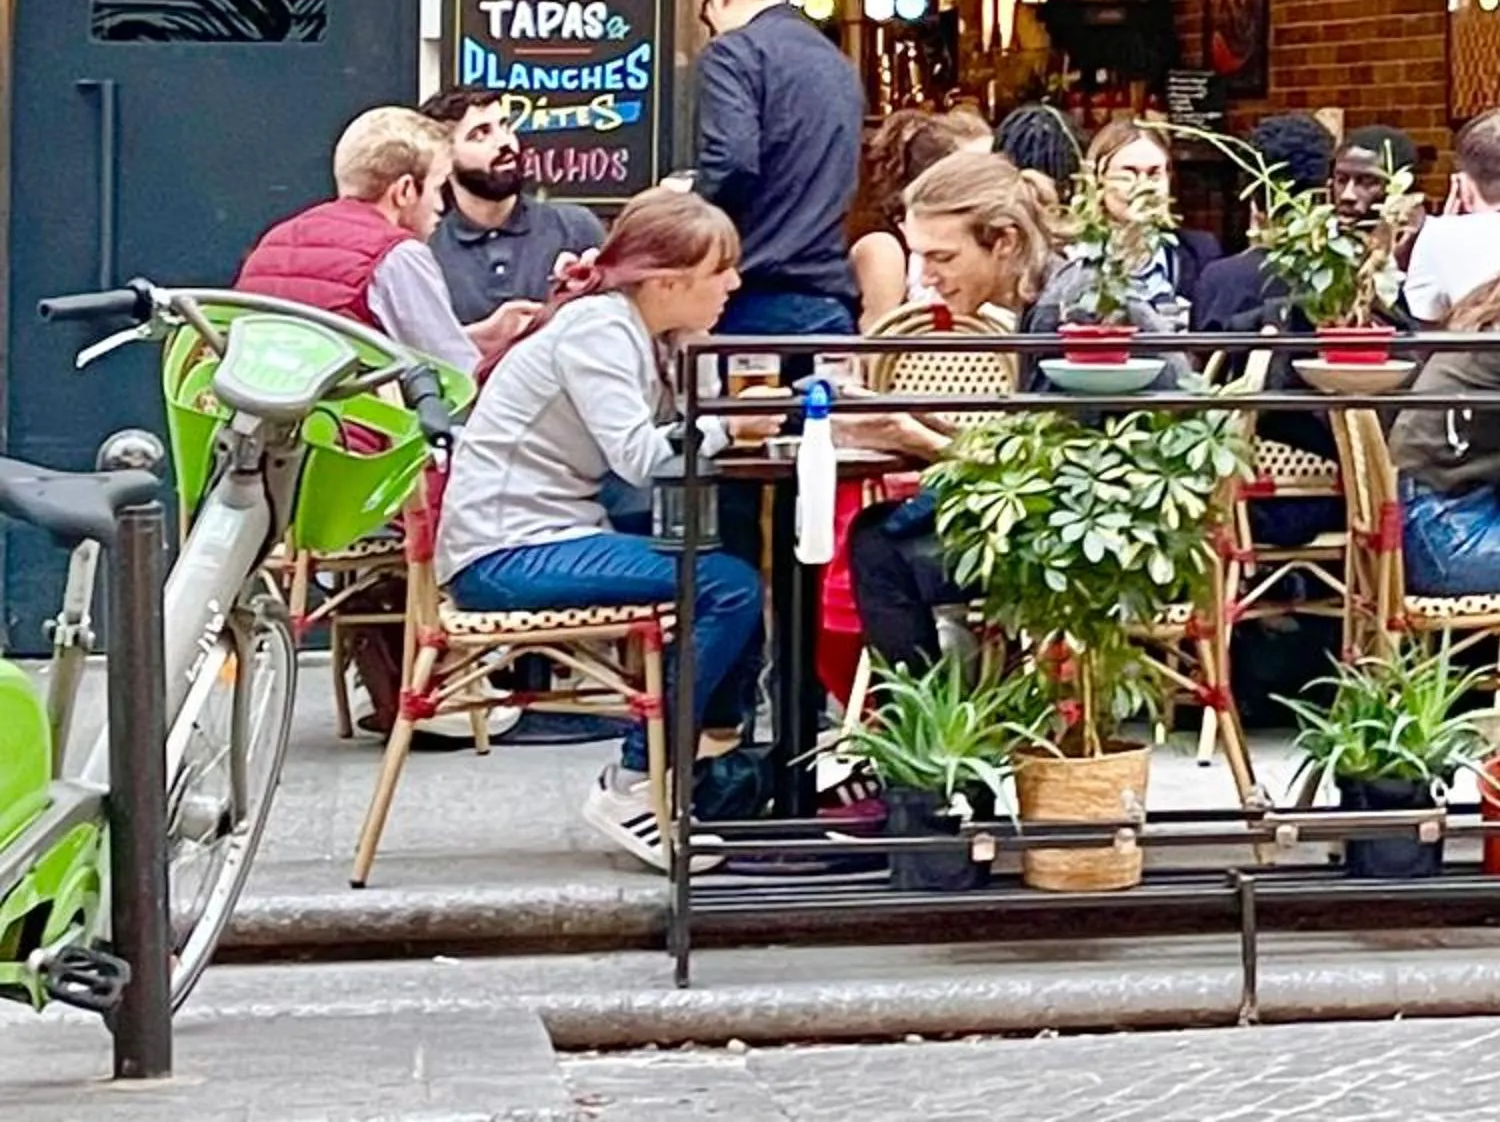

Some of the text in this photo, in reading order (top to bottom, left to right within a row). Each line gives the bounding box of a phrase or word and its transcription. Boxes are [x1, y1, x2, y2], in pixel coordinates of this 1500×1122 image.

[478, 0, 608, 40] TAPAS
[462, 36, 652, 91] PLANCHES
[521, 146, 630, 184] ACHOS
